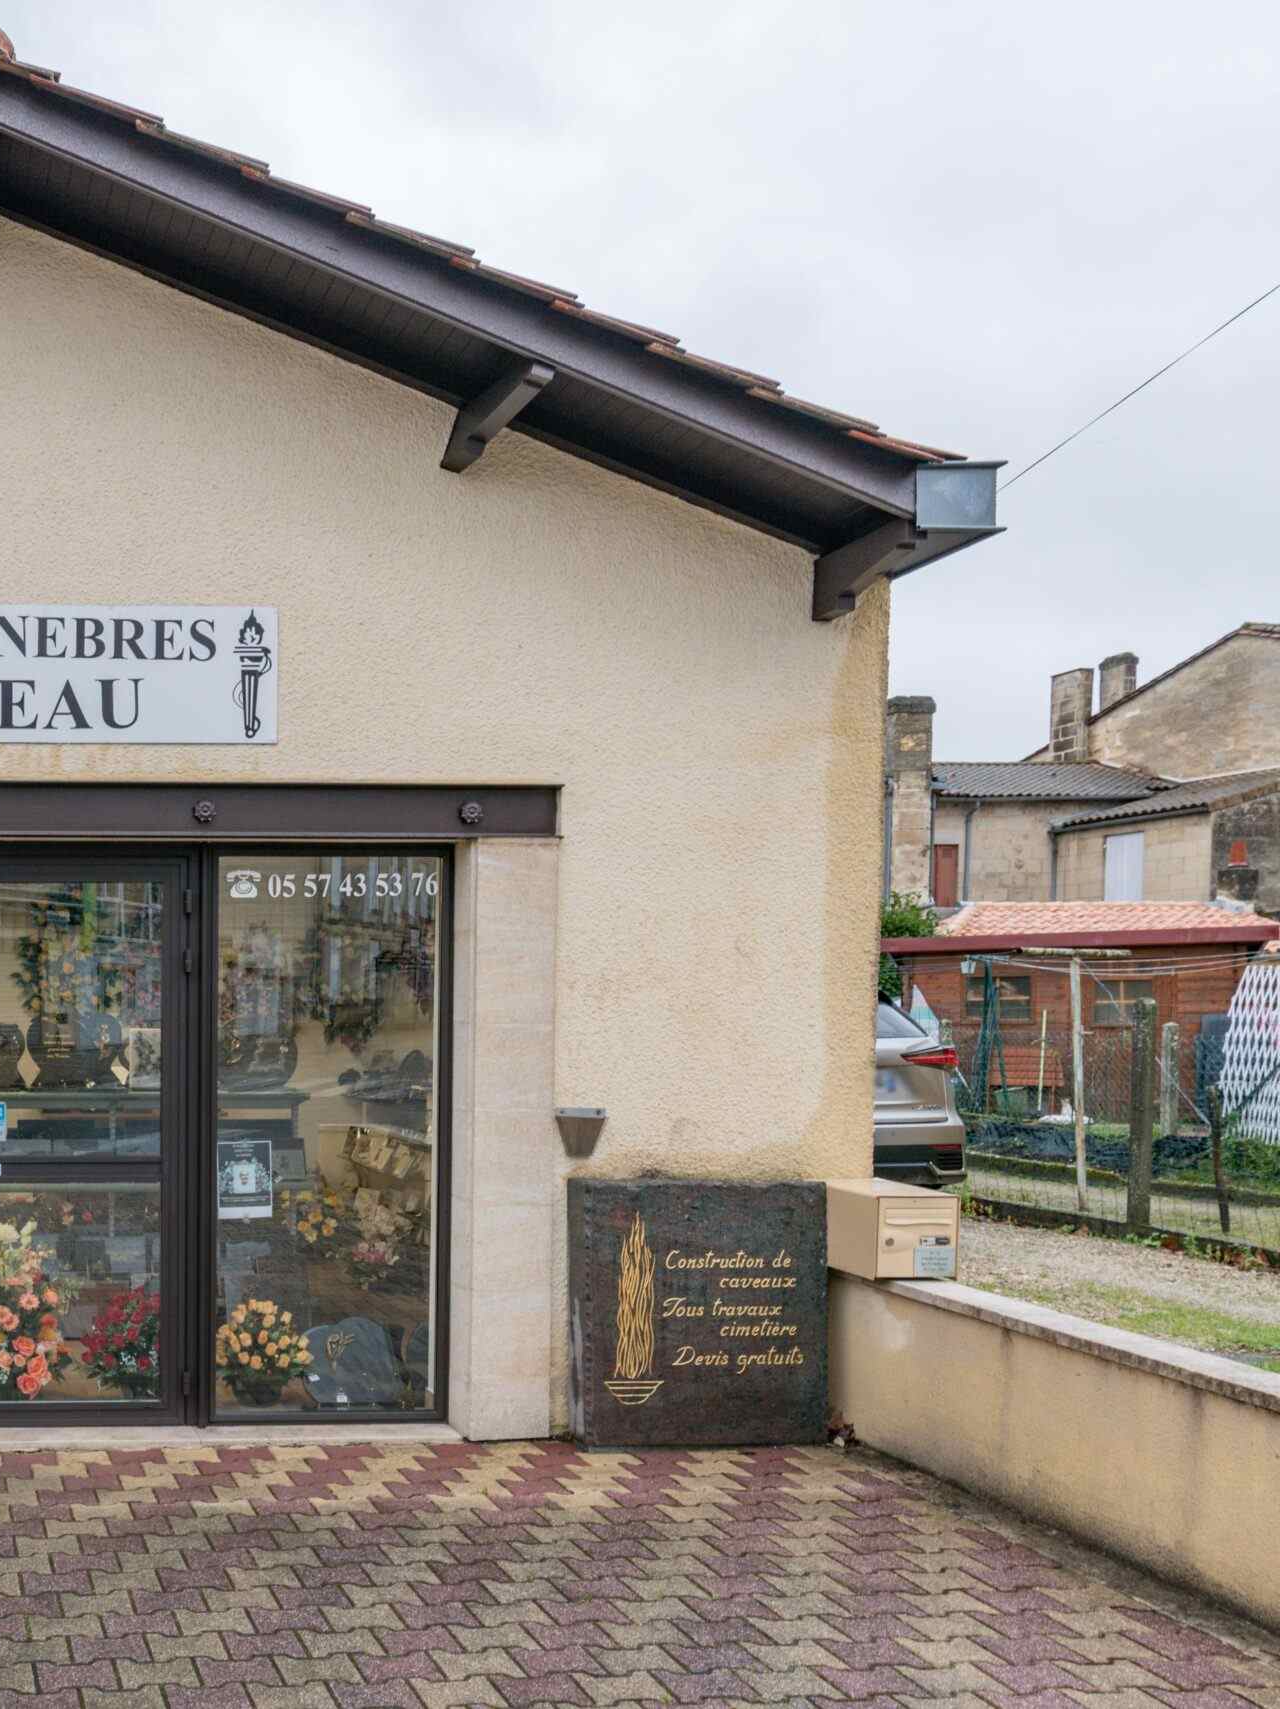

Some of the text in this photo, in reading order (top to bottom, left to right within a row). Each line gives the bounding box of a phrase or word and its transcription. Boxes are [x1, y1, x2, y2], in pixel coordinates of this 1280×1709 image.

[267, 872, 438, 898] 05 57 43 53 76
[665, 1249, 793, 1271] Construction de
[720, 1274, 797, 1289] caveaux
[662, 1297, 783, 1319] Tous travaux
[720, 1319, 798, 1338] cimetière
[671, 1345, 806, 1374] Devis gratuits
